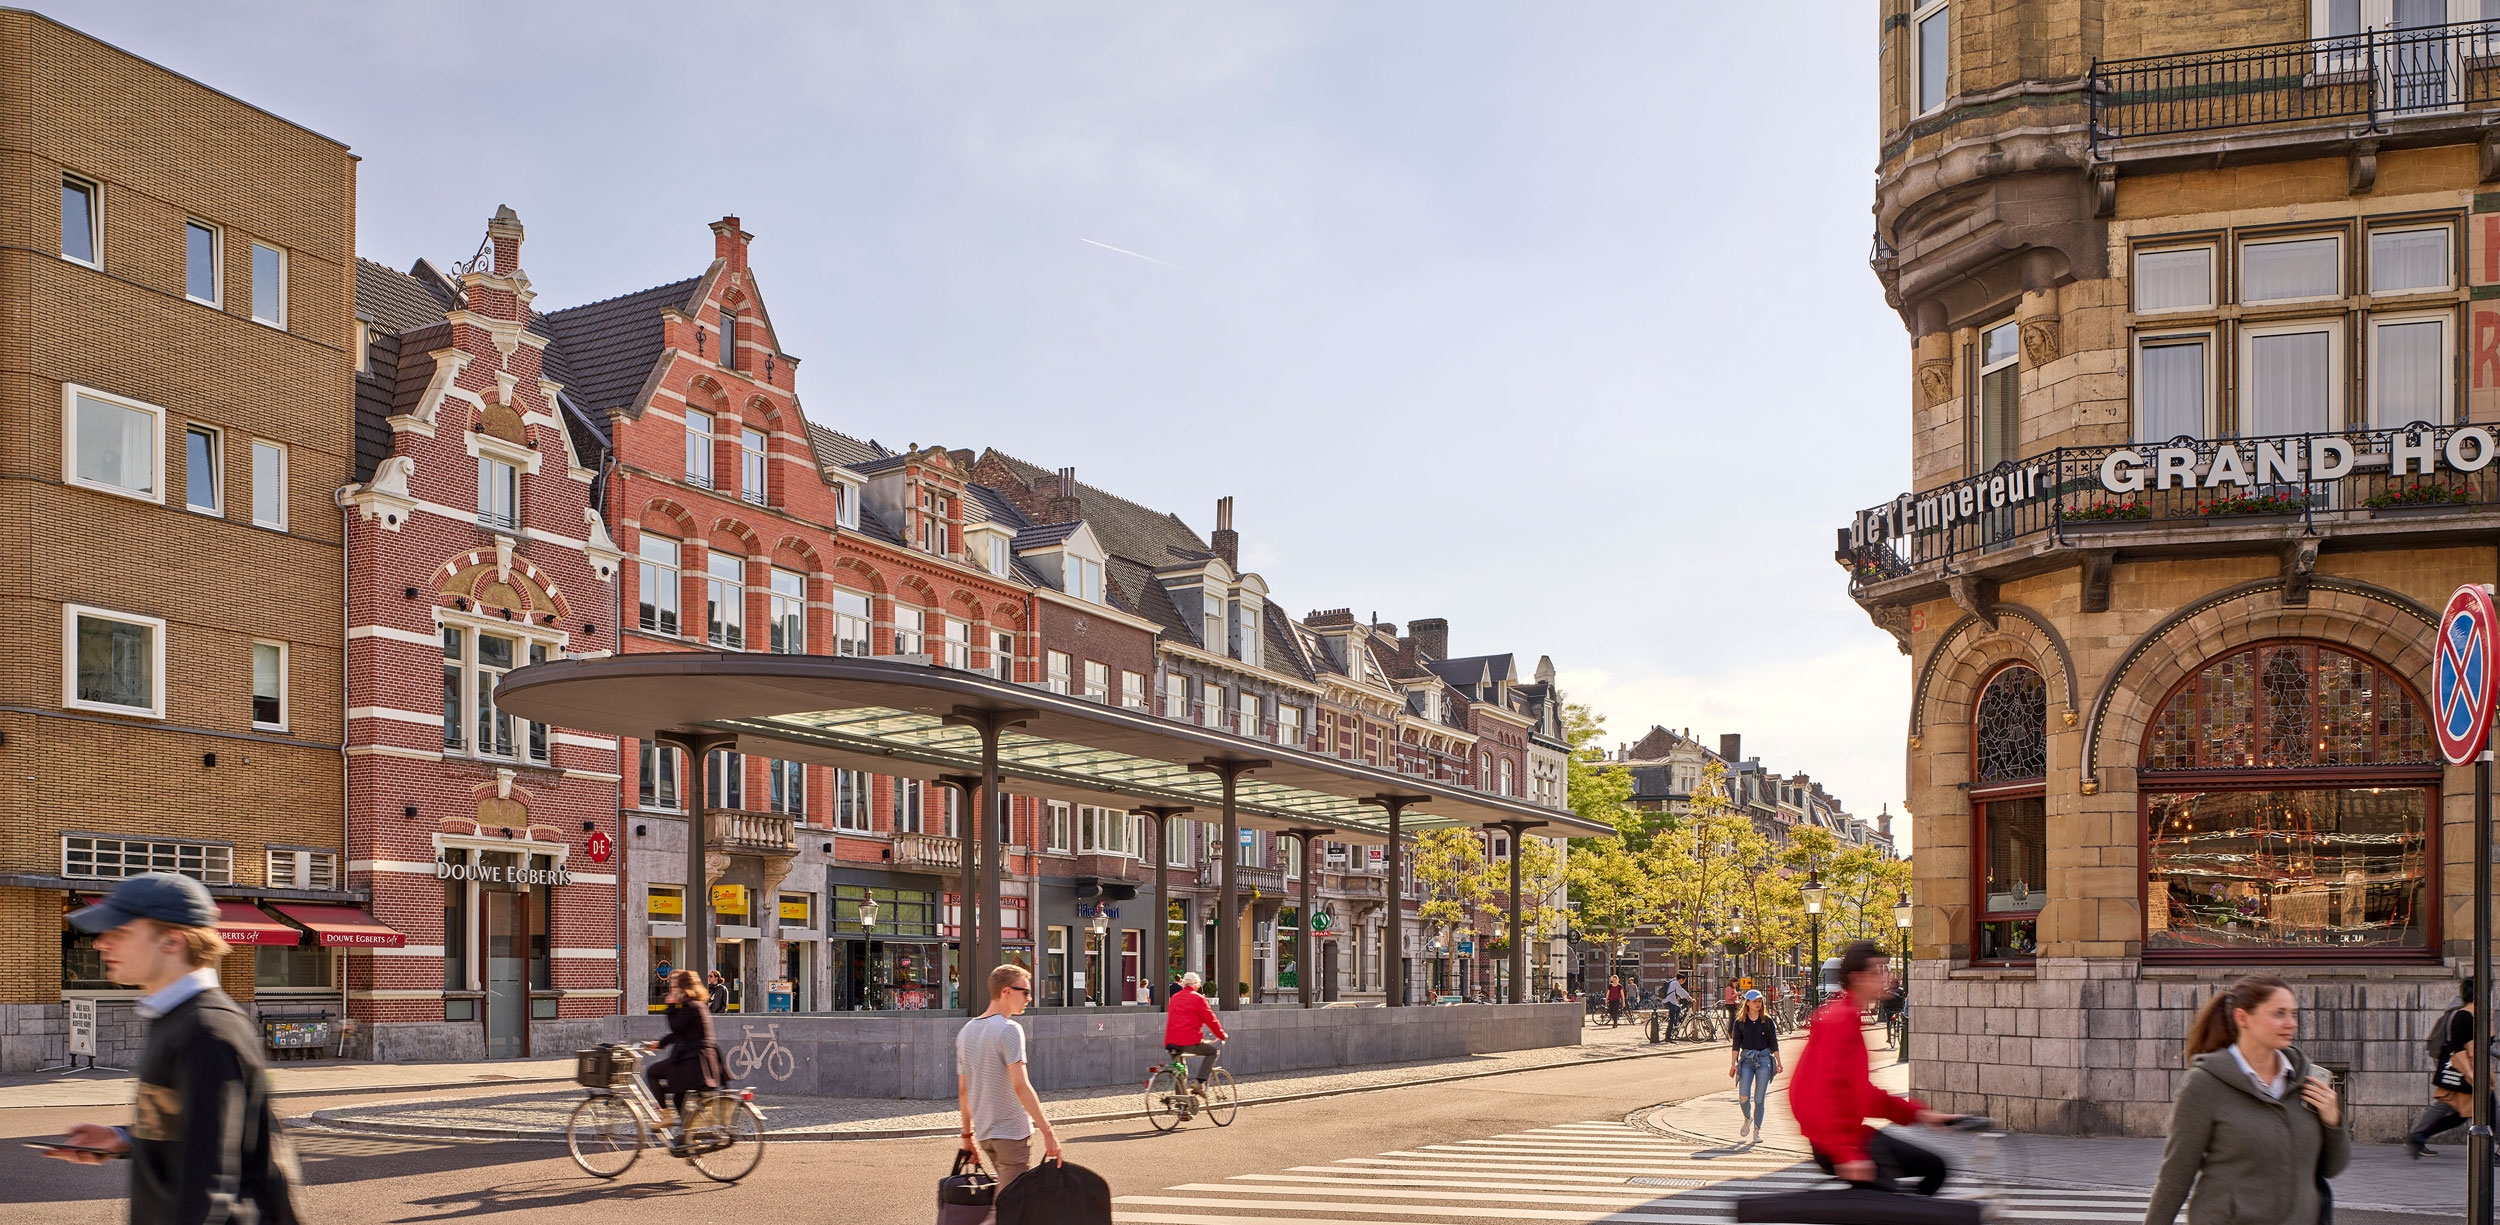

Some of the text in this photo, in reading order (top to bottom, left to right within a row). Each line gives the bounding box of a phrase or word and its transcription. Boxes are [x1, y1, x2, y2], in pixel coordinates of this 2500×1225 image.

[2100, 436, 2356, 495] GRAND
[1850, 464, 2039, 549] de l'Empereur
[437, 862, 573, 886] DOUWE EGBERTS
[1000, 898, 1017, 906] TABAK
[327, 934, 354, 943] DOUWE
[355, 934, 386, 944] EGBERTS
